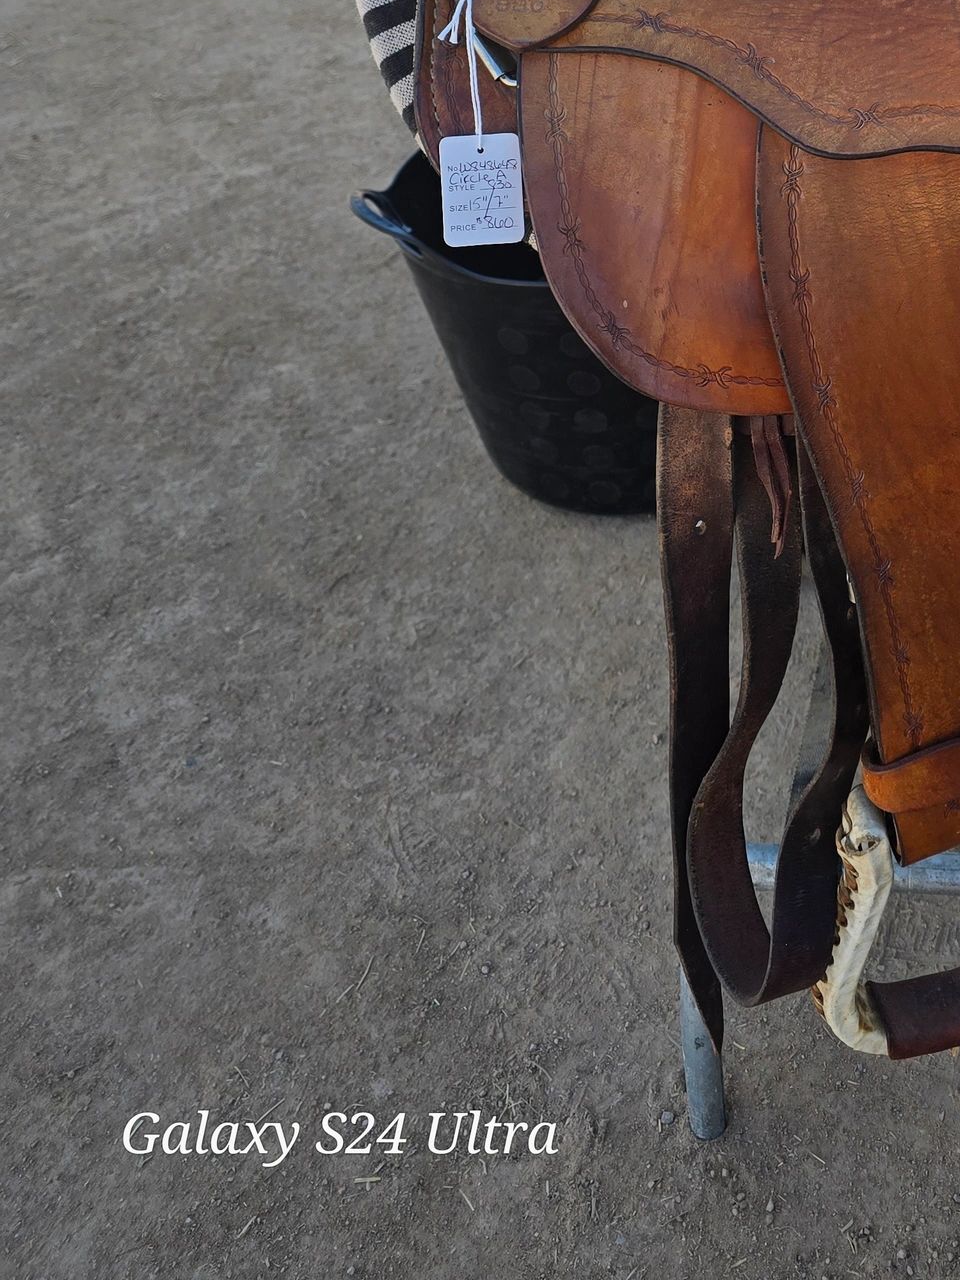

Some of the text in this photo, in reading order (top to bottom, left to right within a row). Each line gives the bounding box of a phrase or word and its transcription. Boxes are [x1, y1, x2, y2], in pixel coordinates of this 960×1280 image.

[449, 169, 507, 185] Circle A
[448, 184, 475, 192] STYLE
[449, 204, 468, 212] SIZE
[450, 223, 477, 232] PRICE
